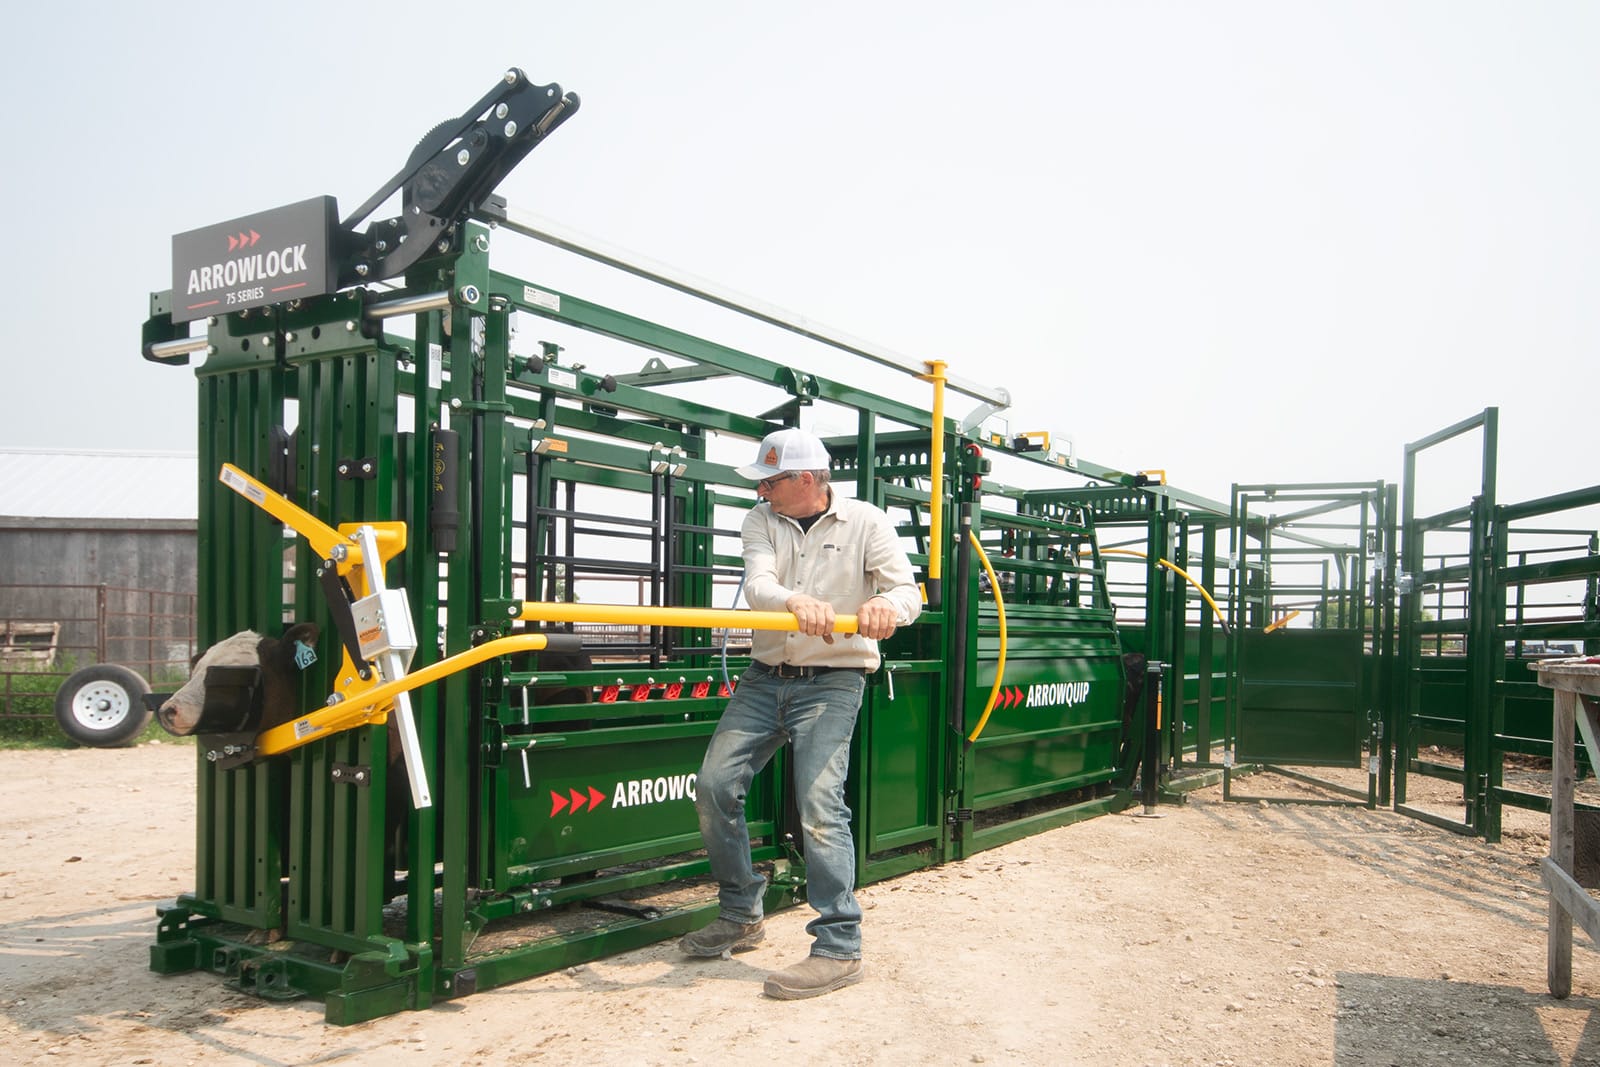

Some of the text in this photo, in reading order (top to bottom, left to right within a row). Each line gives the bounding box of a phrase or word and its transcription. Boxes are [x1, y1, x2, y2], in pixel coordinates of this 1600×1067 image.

[187, 244, 307, 295] ARROWLOCK
[226, 286, 264, 305] 75 SERIES
[297, 650, 317, 669] 162
[1025, 681, 1090, 708] ARROWQUIP
